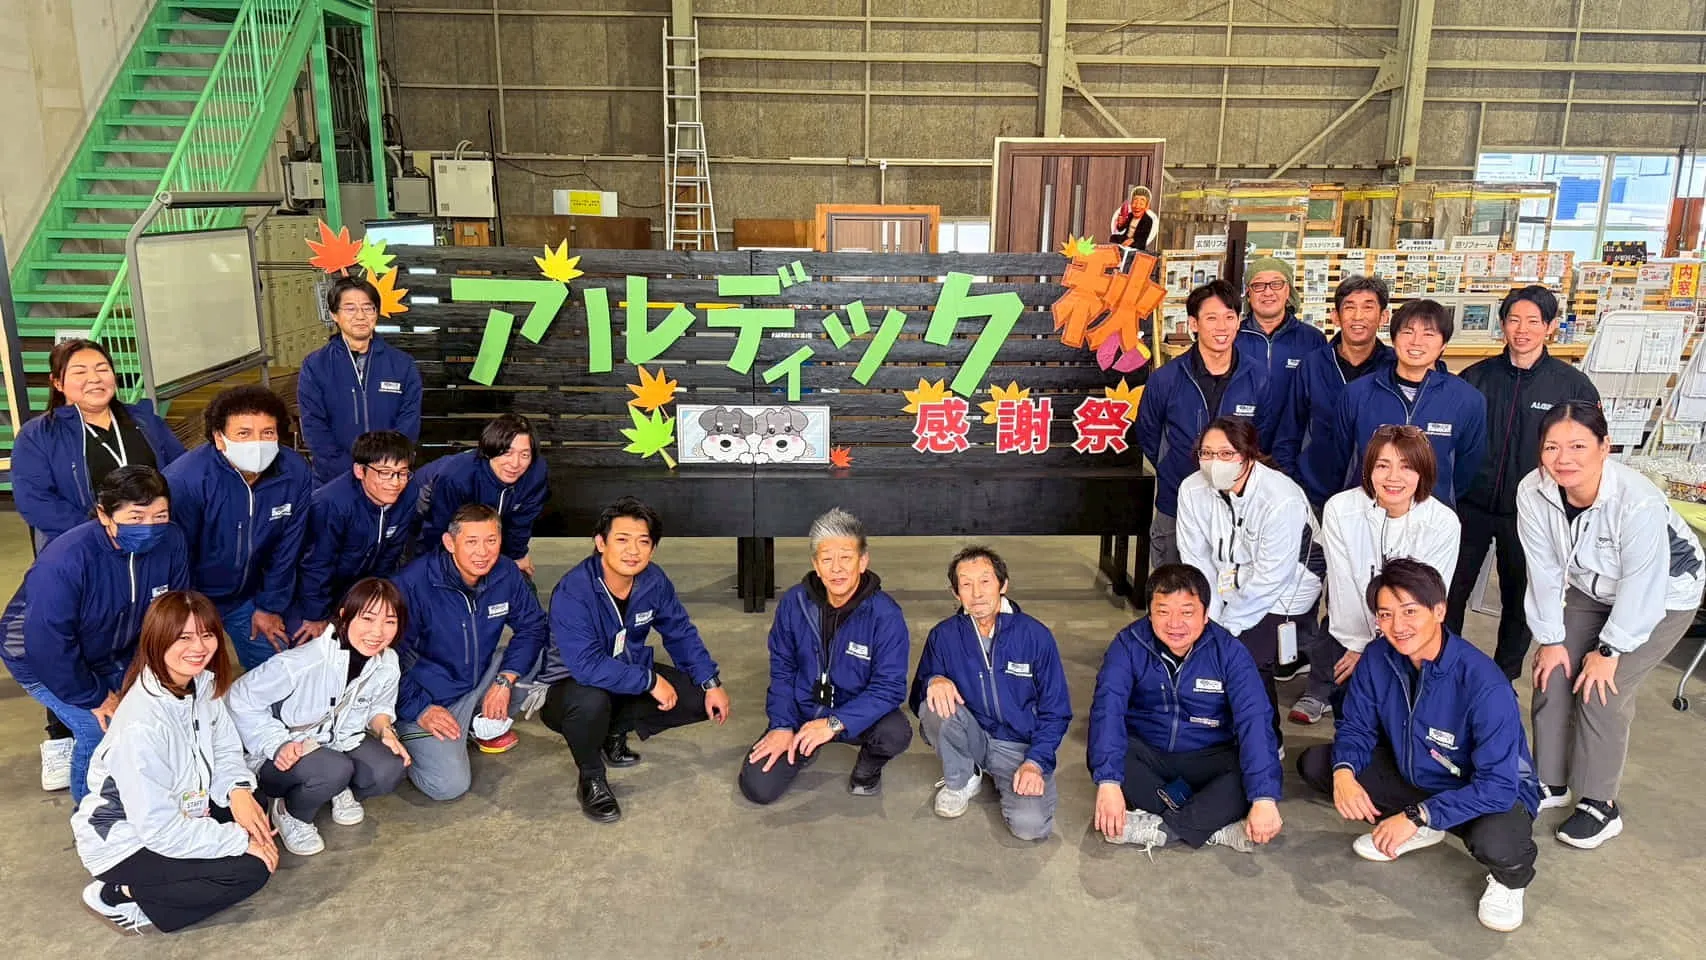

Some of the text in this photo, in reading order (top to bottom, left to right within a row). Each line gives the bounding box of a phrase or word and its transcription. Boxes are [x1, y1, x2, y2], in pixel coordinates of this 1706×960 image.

[450, 259, 1025, 402] アルディック
[1051, 243, 1168, 352] 秋
[911, 396, 1134, 455] 感謝祭
